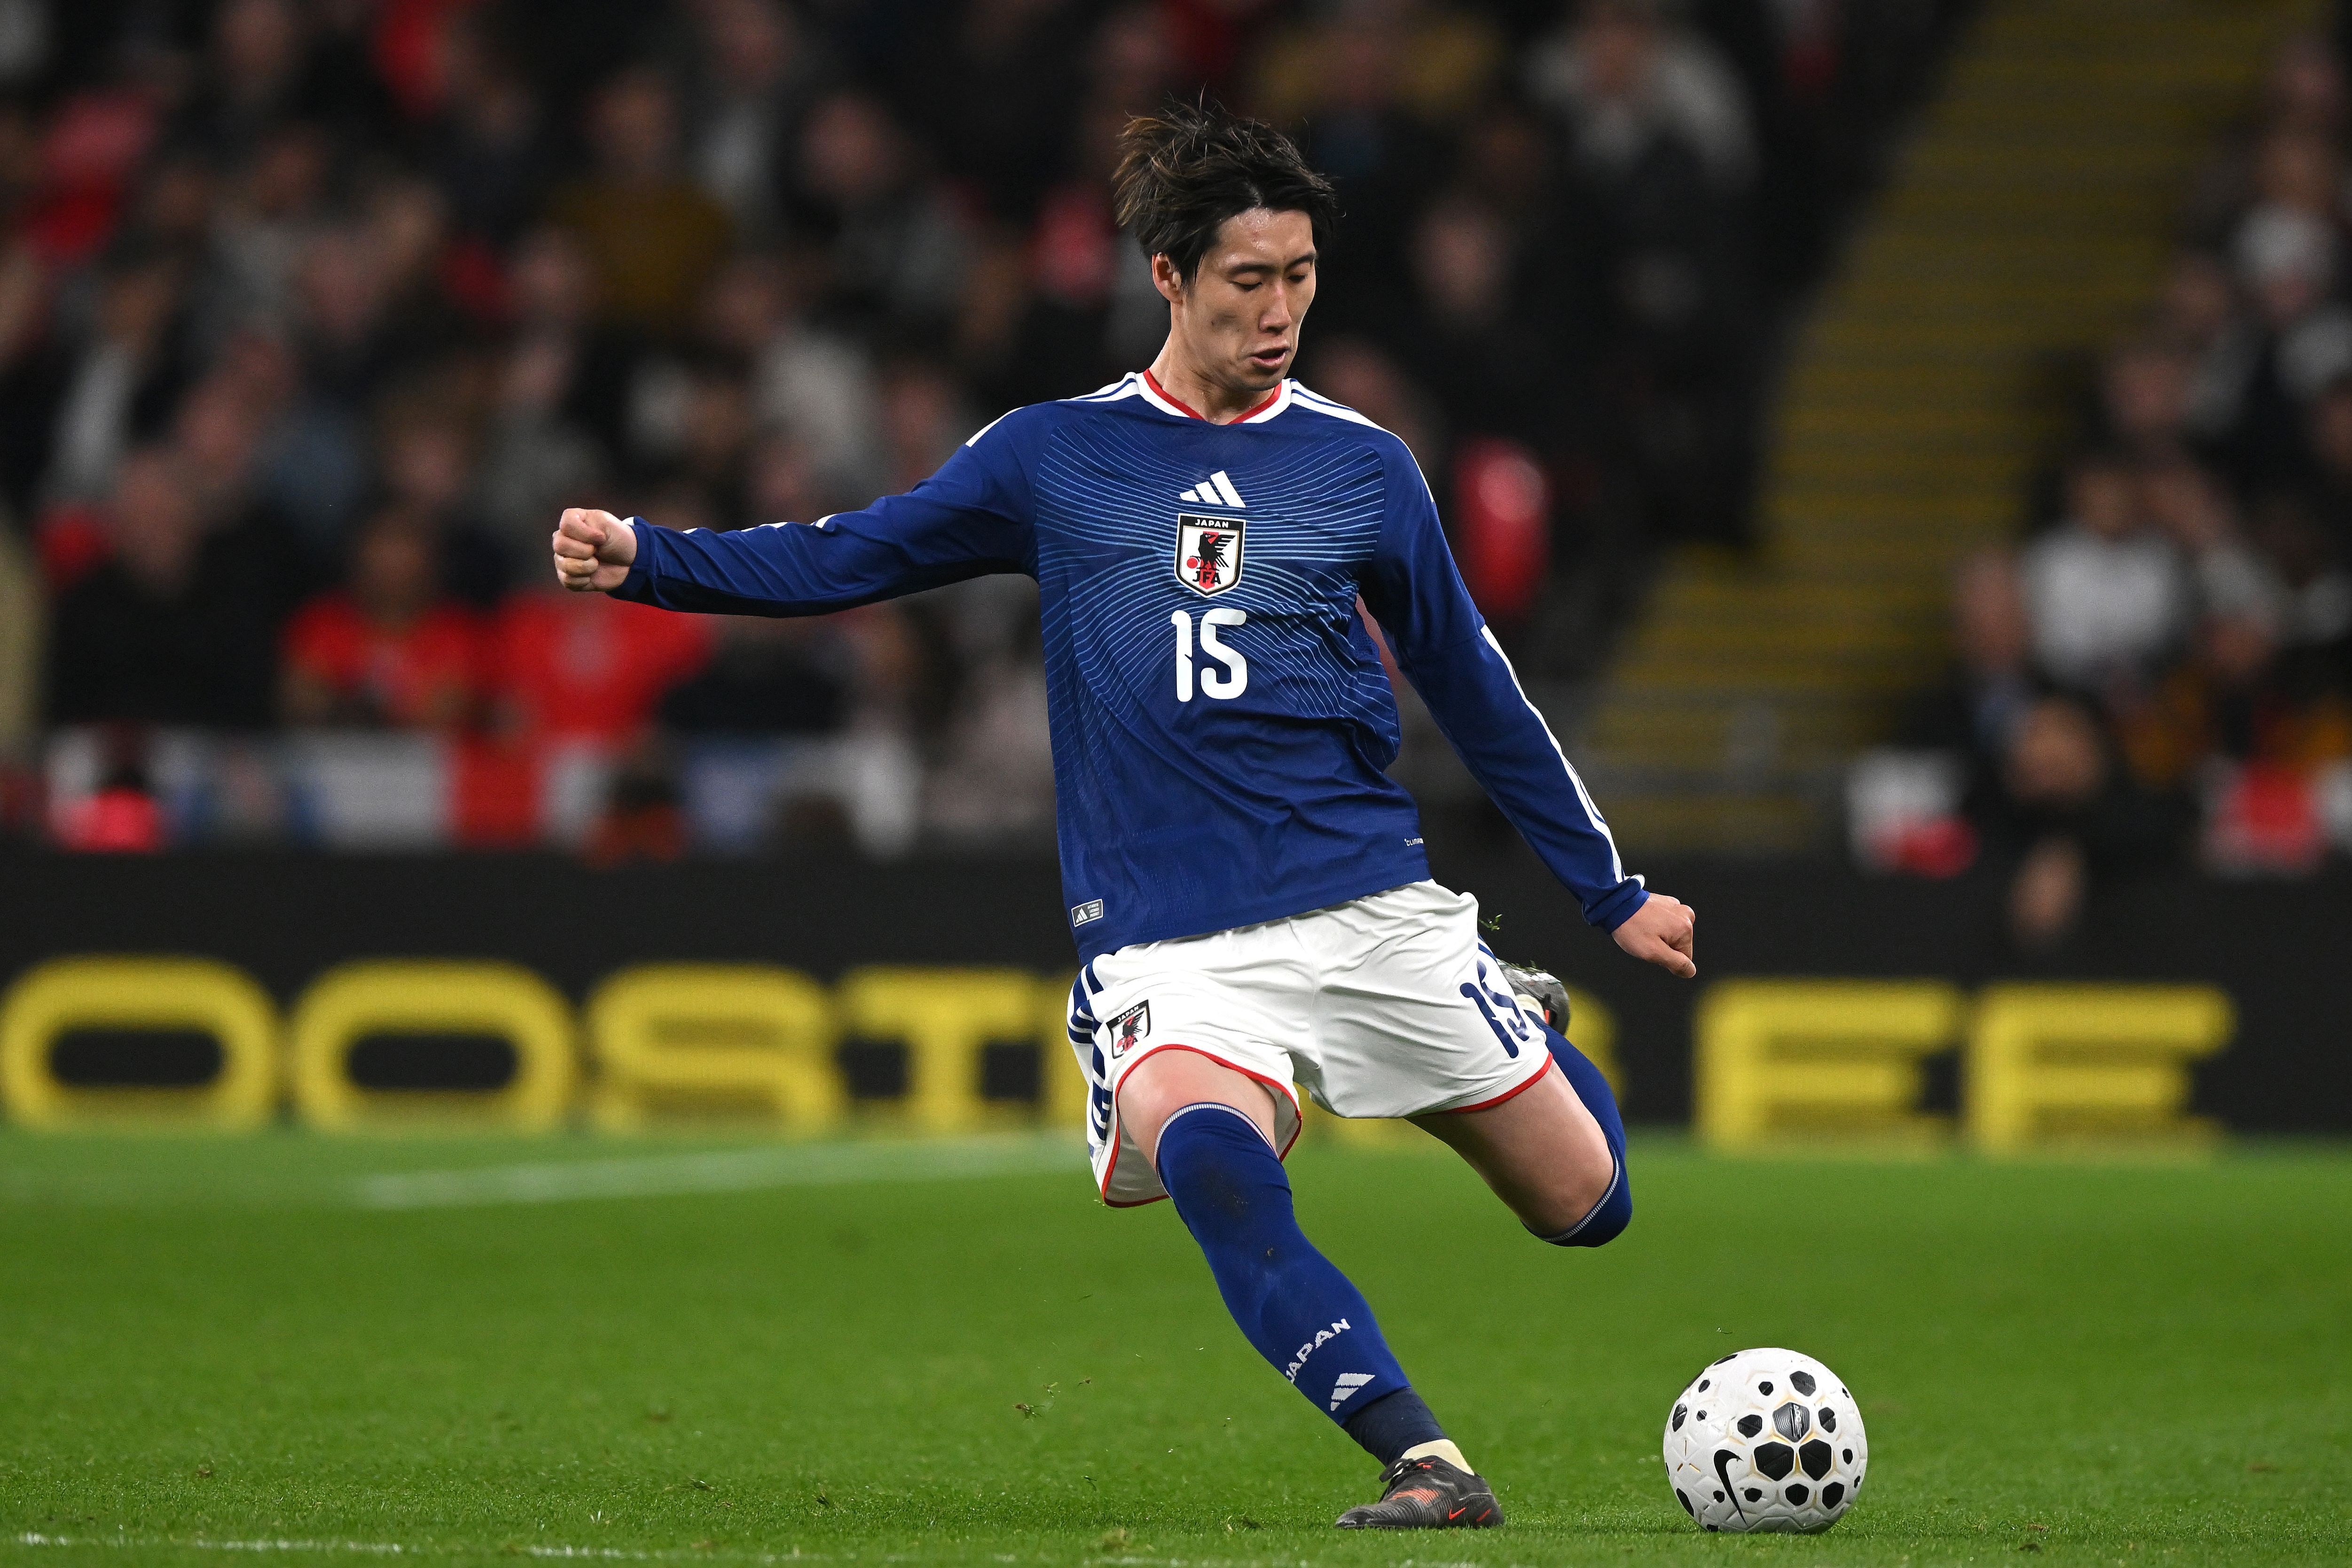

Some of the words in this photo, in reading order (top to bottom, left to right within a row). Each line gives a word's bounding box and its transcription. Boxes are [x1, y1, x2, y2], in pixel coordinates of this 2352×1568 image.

[1195, 519, 1229, 528] JAPAN
[1192, 571, 1221, 584] JFA
[1171, 608, 1247, 702] 15
[1117, 1005, 1139, 1023] JAPAN
[1460, 959, 1529, 1058] 15
[1286, 1318, 1351, 1385] JAPAN
